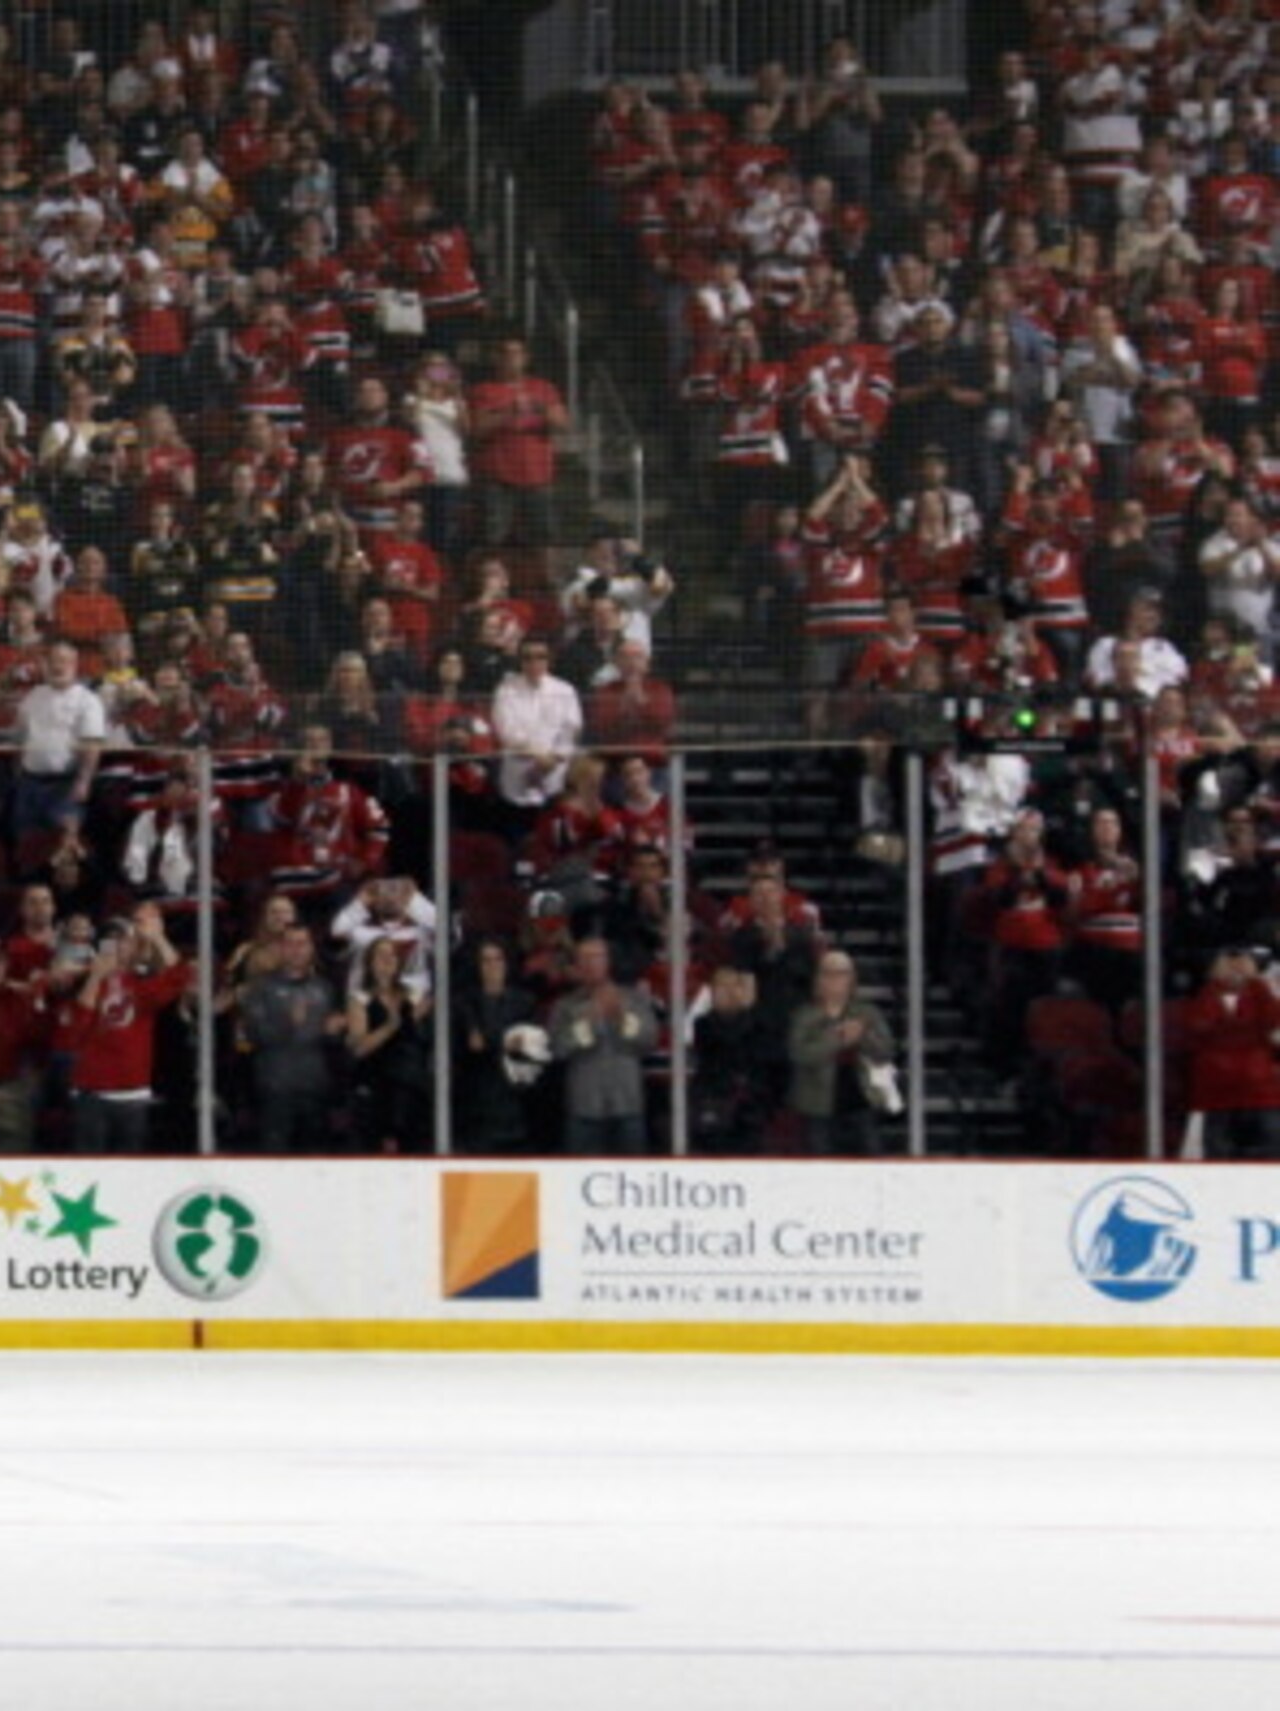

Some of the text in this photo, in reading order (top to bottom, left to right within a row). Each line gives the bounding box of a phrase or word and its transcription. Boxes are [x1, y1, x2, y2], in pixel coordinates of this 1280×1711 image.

[580, 1171, 747, 1209] Chilton
[581, 1219, 924, 1259] Medical Center
[7, 1257, 149, 1300] Lottery
[581, 1284, 923, 1304] ATLANTIC HEALTH SYSTEM
